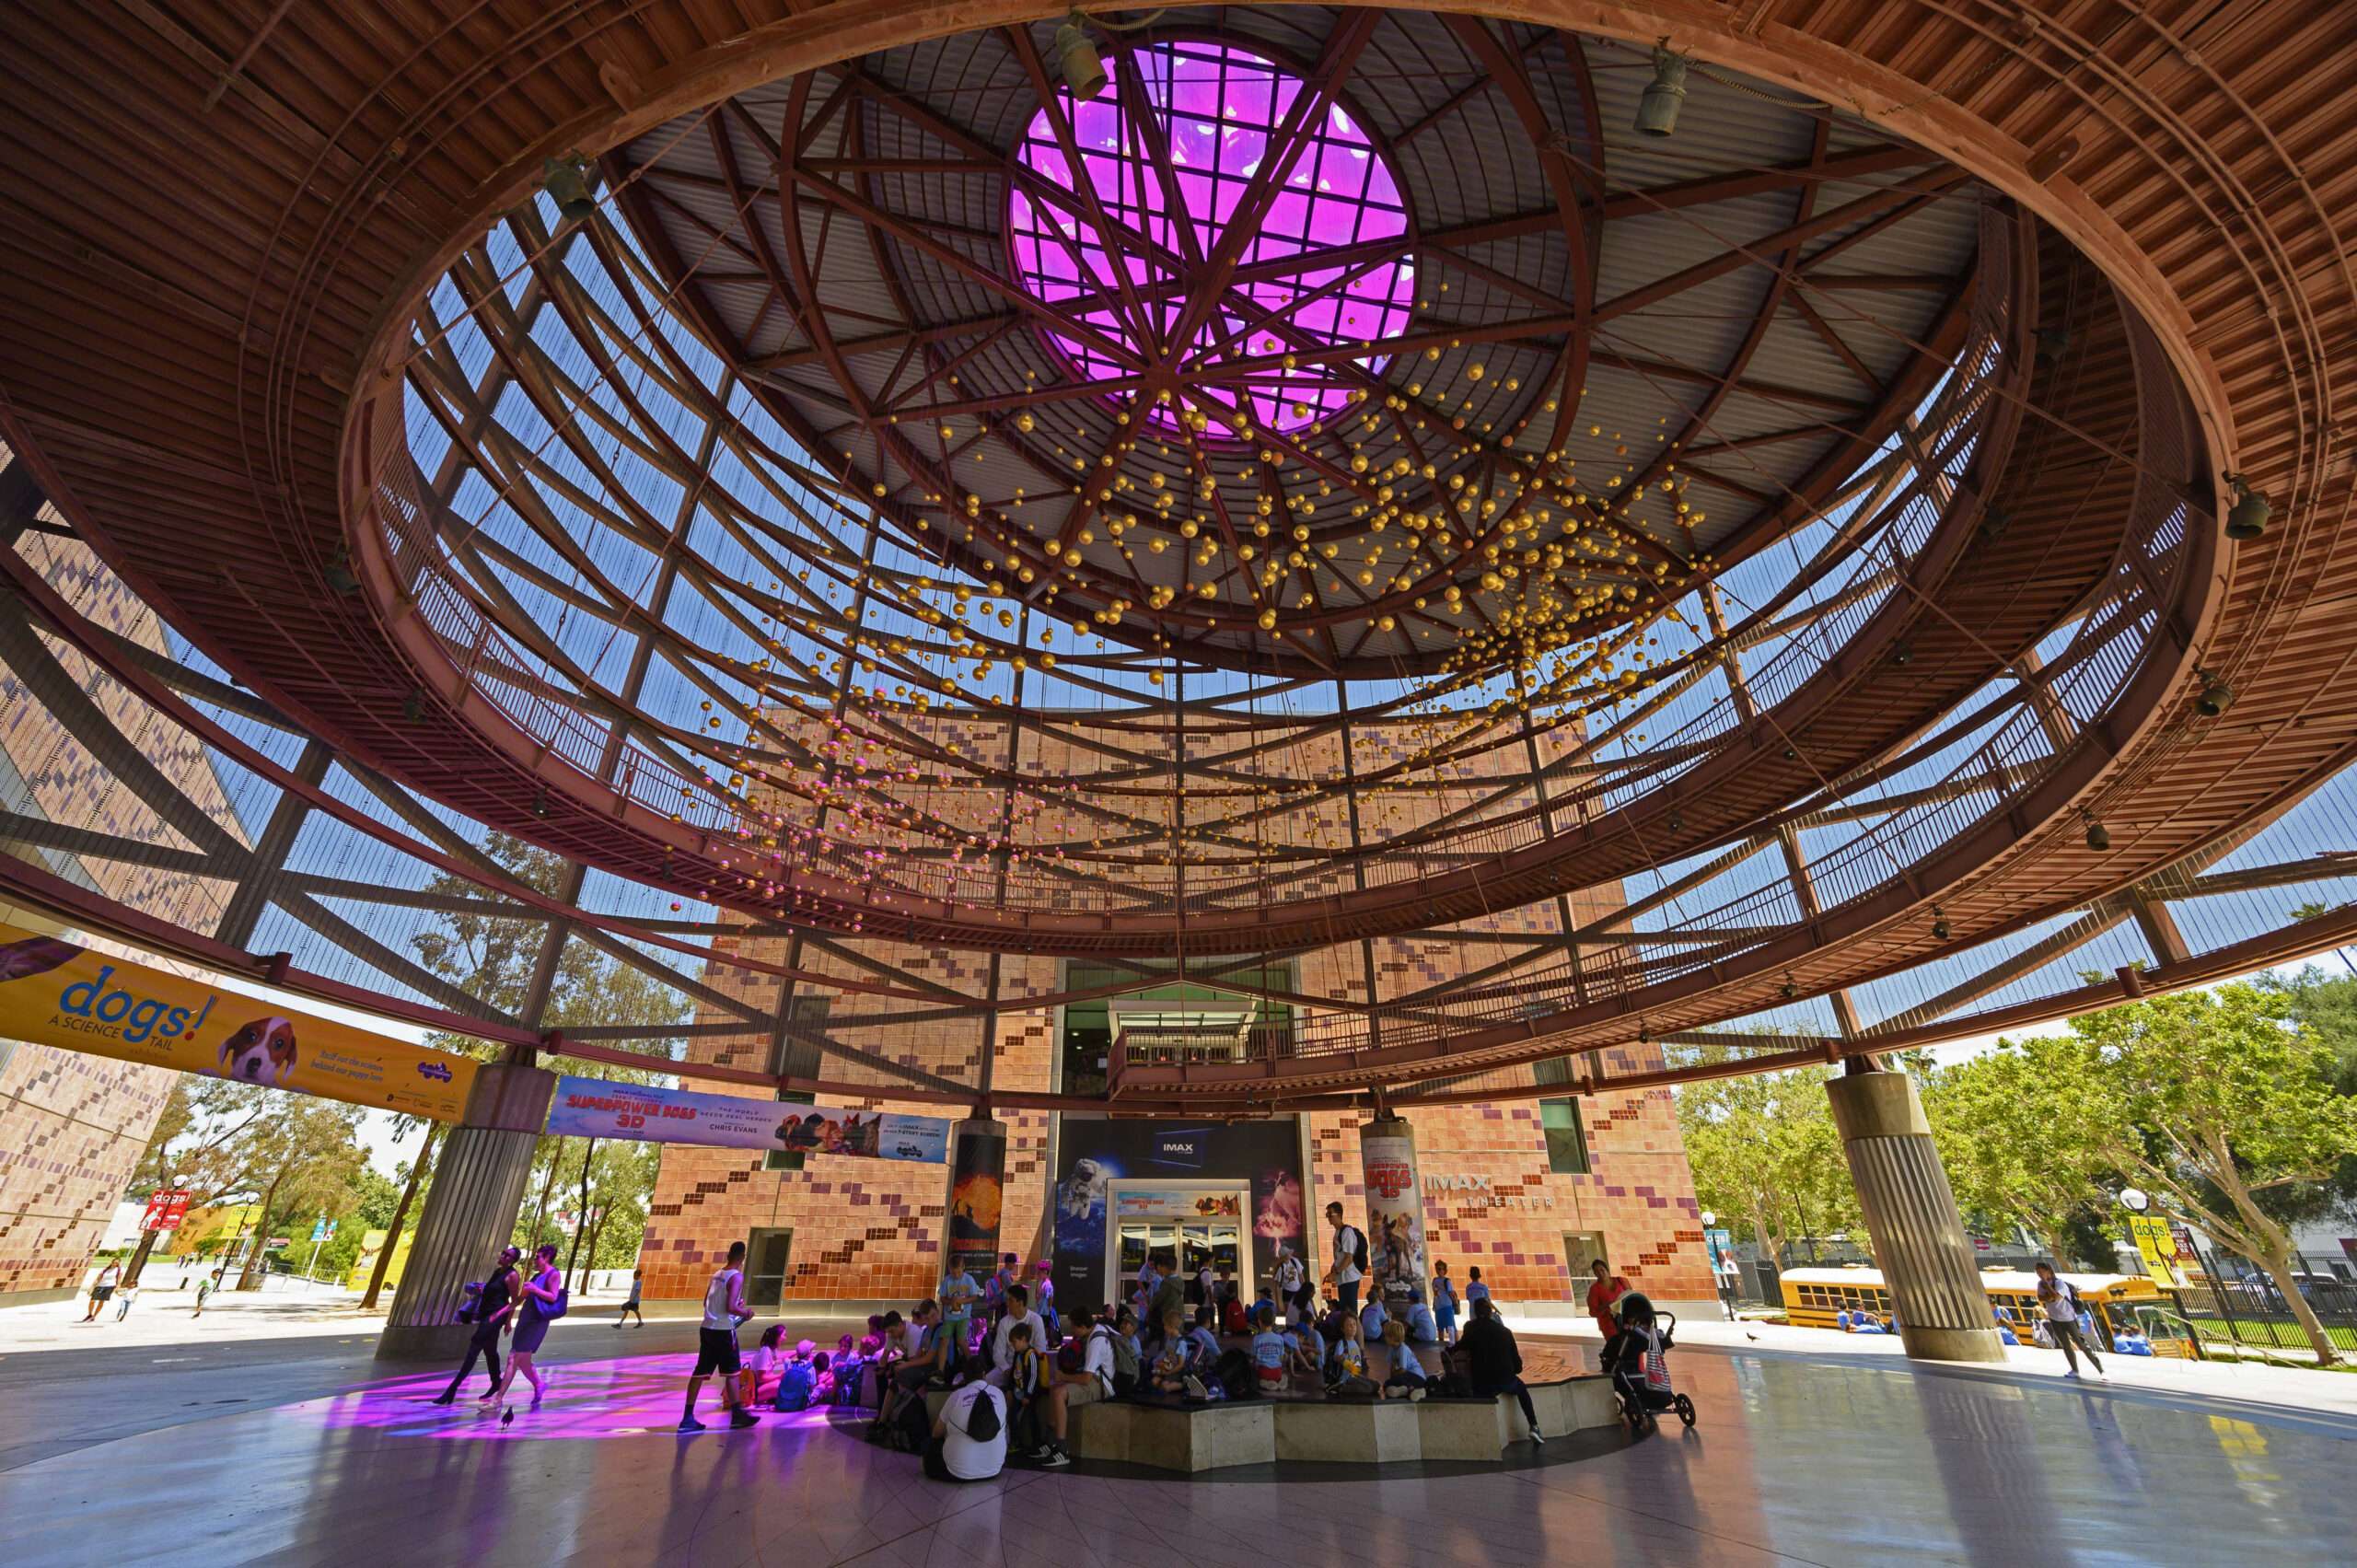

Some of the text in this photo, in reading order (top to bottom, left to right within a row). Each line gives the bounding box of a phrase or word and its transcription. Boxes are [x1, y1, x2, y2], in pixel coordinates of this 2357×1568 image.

[59, 965, 220, 1043] dogs!
[48, 1015, 122, 1039] A SCIENCE
[149, 1035, 174, 1051] TAIL
[566, 1095, 660, 1117] SUPERPOWER
[662, 1105, 698, 1120] DOGS
[616, 1114, 645, 1129] 3D
[709, 1123, 732, 1132] CHRIS
[734, 1125, 758, 1133] EVANS
[1425, 1175, 1489, 1191] IMAX
[153, 1191, 192, 1204] dogs!
[1468, 1197, 1554, 1208] THEATER
